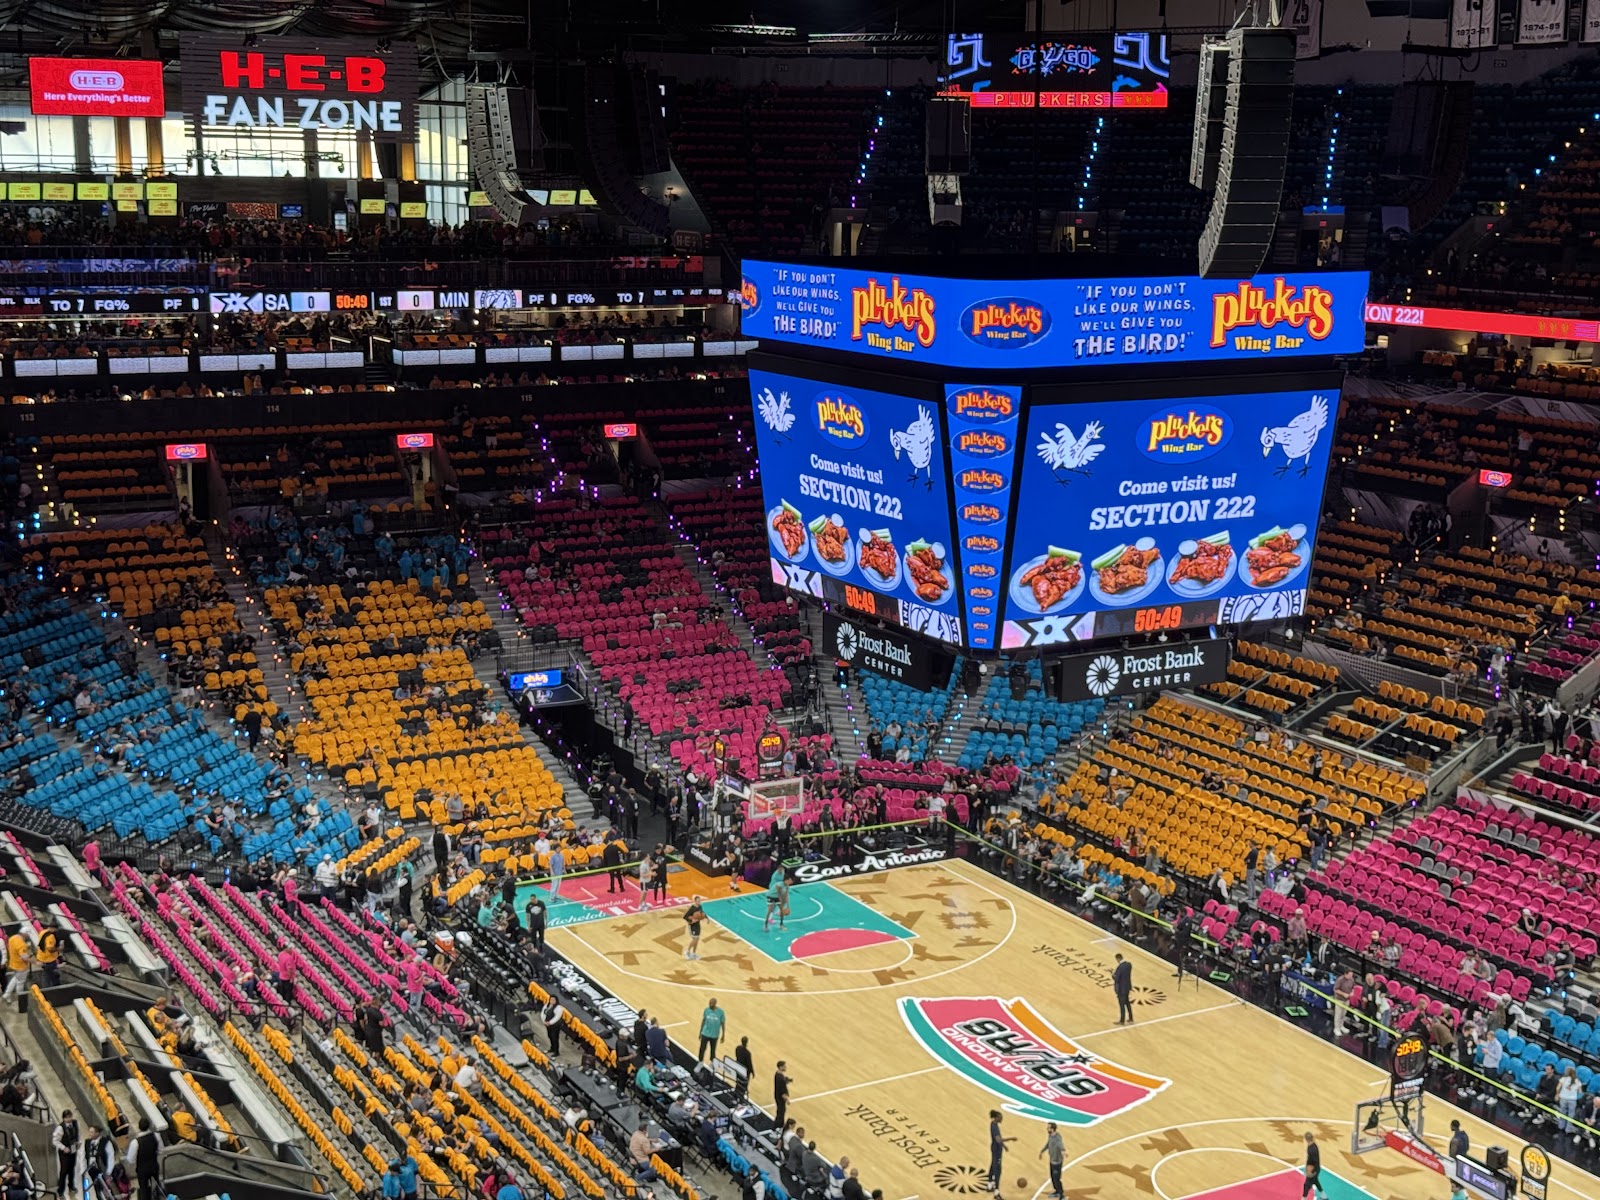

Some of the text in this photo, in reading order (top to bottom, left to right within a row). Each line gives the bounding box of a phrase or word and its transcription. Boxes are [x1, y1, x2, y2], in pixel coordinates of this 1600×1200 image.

[44, 92, 151, 104] Here Everything's Better
[994, 93, 1105, 106] PLUCKERS
[203, 95, 402, 131] FAN ZONE
[791, 270, 807, 284] YOU
[809, 272, 836, 285] DON'T
[529, 294, 544, 304] PF
[567, 293, 595, 304] FG%
[617, 293, 632, 303] TO
[772, 285, 791, 297] LIKE
[792, 286, 808, 299] OUR
[1109, 286, 1137, 298] YOU
[1143, 282, 1187, 297] DON'T
[50, 300, 71, 312] TO
[94, 300, 130, 311] FG%
[164, 300, 182, 311] PF
[264, 294, 368, 311] SA 0 50:49
[413, 292, 469, 308] 0 MIN
[776, 301, 835, 317] WE'LL GIVE YOU
[1075, 303, 1106, 316] LIKE
[1110, 302, 1139, 314] OUR
[1395, 308, 1424, 325] 222!
[773, 315, 796, 334] THE
[1080, 316, 1182, 331] WE'LL GIVE YOU
[867, 333, 915, 352] Wing Bar
[986, 330, 1027, 340] Wing Bar
[1234, 335, 1304, 352] Wing Bar
[1072, 337, 1115, 358] THE
[266, 405, 280, 413] 114
[827, 425, 843, 440] Wing
[1162, 442, 1204, 454] Wing Bar
[810, 453, 883, 485] Come visit us!
[1118, 472, 1237, 497] Come visit us!
[799, 473, 903, 521] SECTION 222
[1089, 495, 1256, 531] SECTION 222
[844, 584, 876, 615] 50:49
[1134, 606, 1182, 632] 50:49
[858, 629, 912, 667] Frost Bank
[864, 655, 903, 678] CENTER
[1122, 645, 1205, 676] Frost Bank
[1132, 672, 1191, 689] CENTER
[795, 849, 946, 883] San Antonio
[1032, 944, 1114, 989] Frost Bank
[941, 1027, 1061, 1100] SAN ANTONIO
[844, 1103, 943, 1169] Frost Bank
[886, 1108, 951, 1153] CENTER
